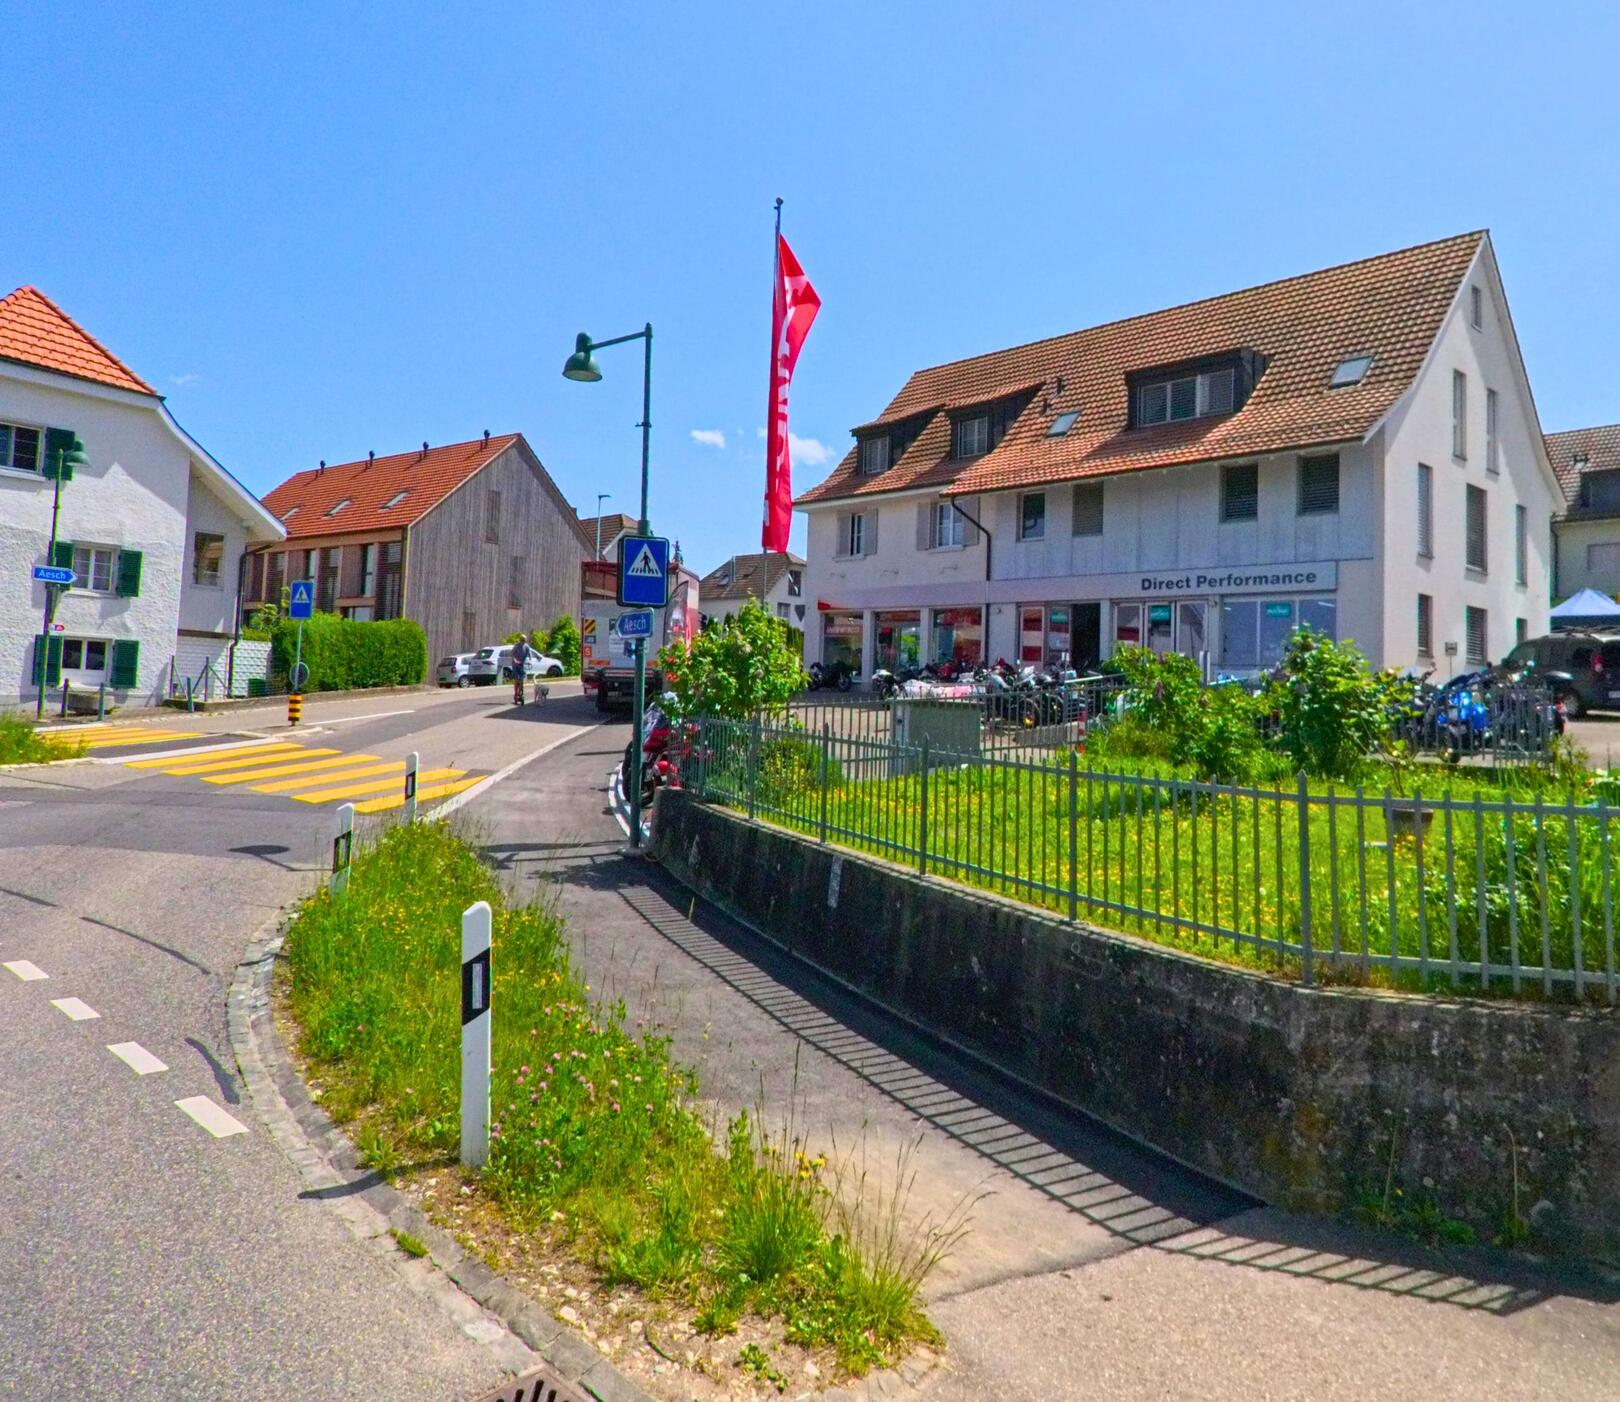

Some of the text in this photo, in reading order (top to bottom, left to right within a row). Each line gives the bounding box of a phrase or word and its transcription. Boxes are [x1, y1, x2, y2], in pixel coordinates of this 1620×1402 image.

[39, 569, 66, 580] Aesch
[1141, 572, 1317, 590] Direct Performance
[624, 616, 646, 631] Aesch
